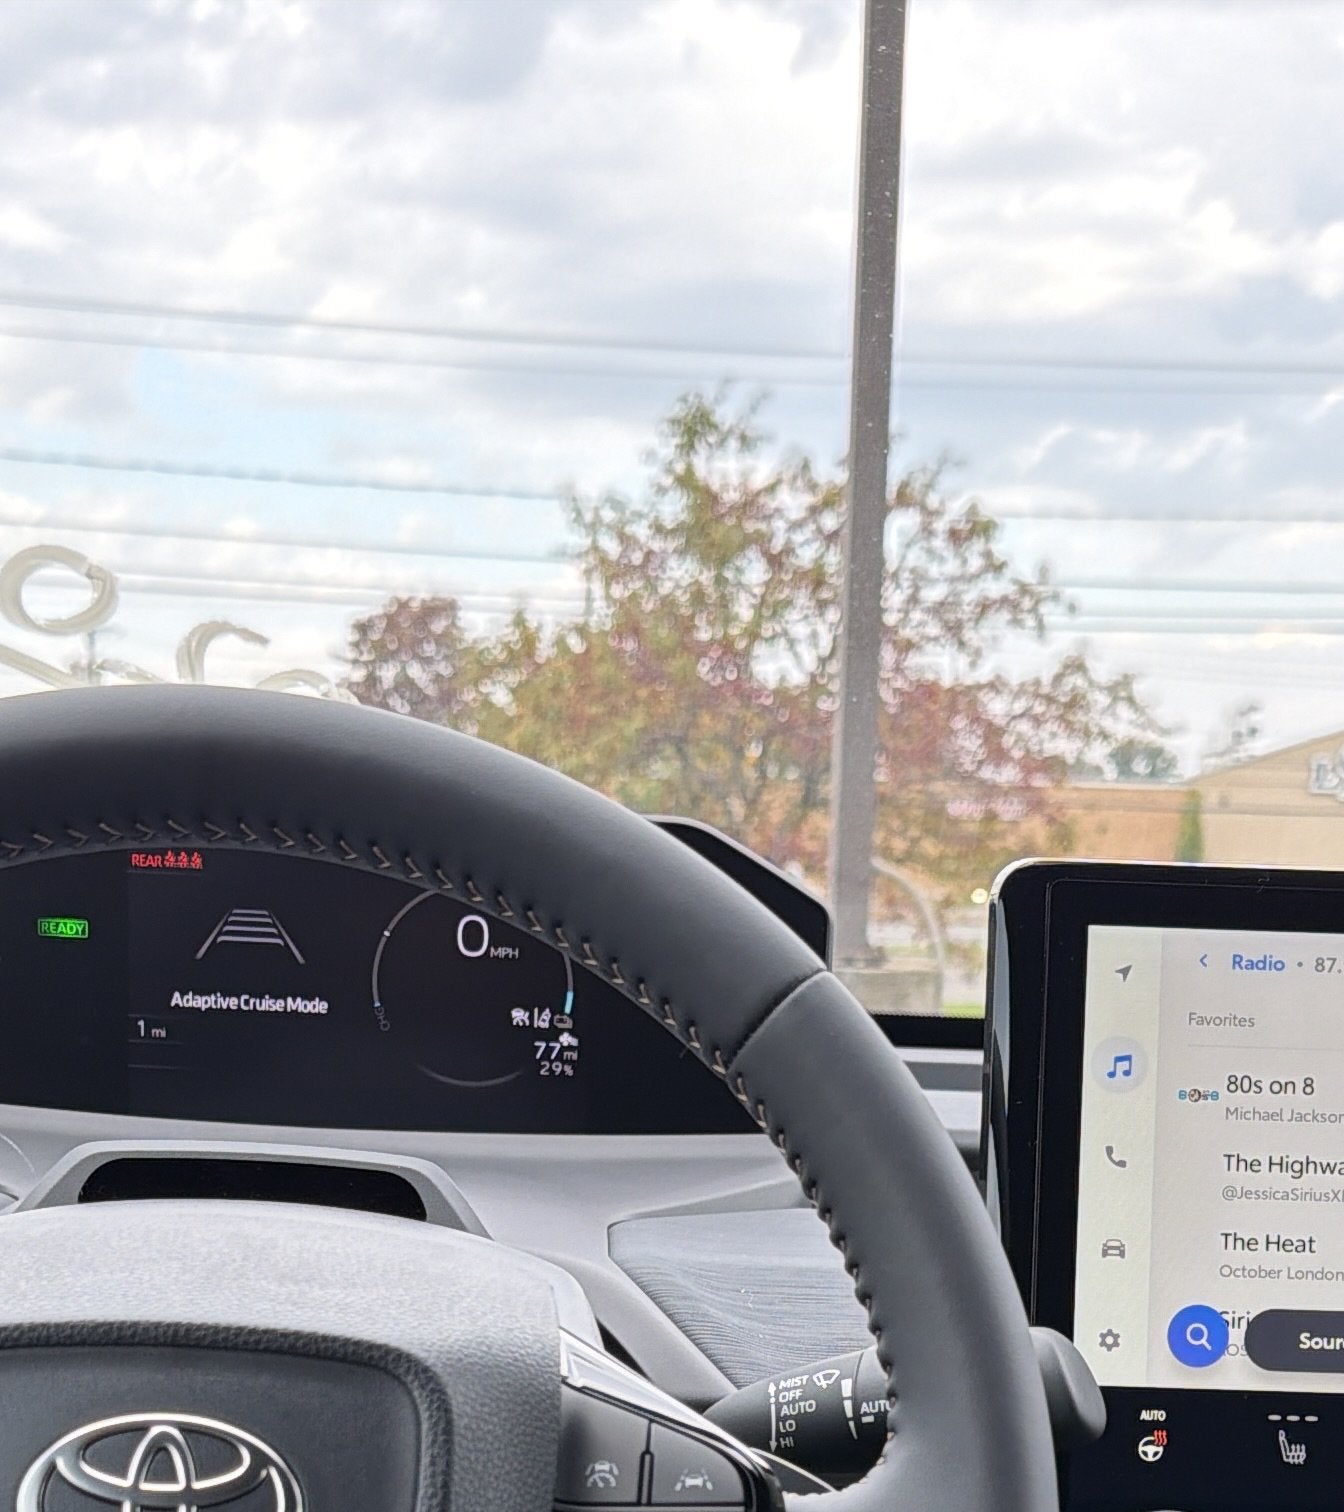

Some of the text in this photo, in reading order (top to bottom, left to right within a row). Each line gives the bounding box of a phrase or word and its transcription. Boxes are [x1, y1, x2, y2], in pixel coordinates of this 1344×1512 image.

[131, 853, 163, 868] REAR
[40, 920, 85, 937] READY
[456, 914, 519, 960] 0 MPH
[1231, 953, 1286, 972] Radio
[170, 991, 329, 1014] Adaptive Cruise Mode
[1188, 1012, 1256, 1028] Favorites
[136, 1019, 167, 1038] 1 mi
[534, 1041, 578, 1061] 77 mi
[539, 1061, 574, 1077] 29%
[1225, 1074, 1264, 1096] 80s
[1269, 1080, 1296, 1095] on
[1301, 1076, 1316, 1096] 8
[1224, 1106, 1284, 1122] Michael
[1222, 1153, 1262, 1173] The
[1220, 1231, 1317, 1254] The Heat
[1218, 1264, 1283, 1280] October
[778, 1374, 809, 1390] MIST
[778, 1388, 804, 1403] OFF
[780, 1399, 817, 1417] AUTO
[1140, 1409, 1166, 1422] AUTO
[779, 1419, 796, 1433] LO
[779, 1436, 795, 1449] HI
